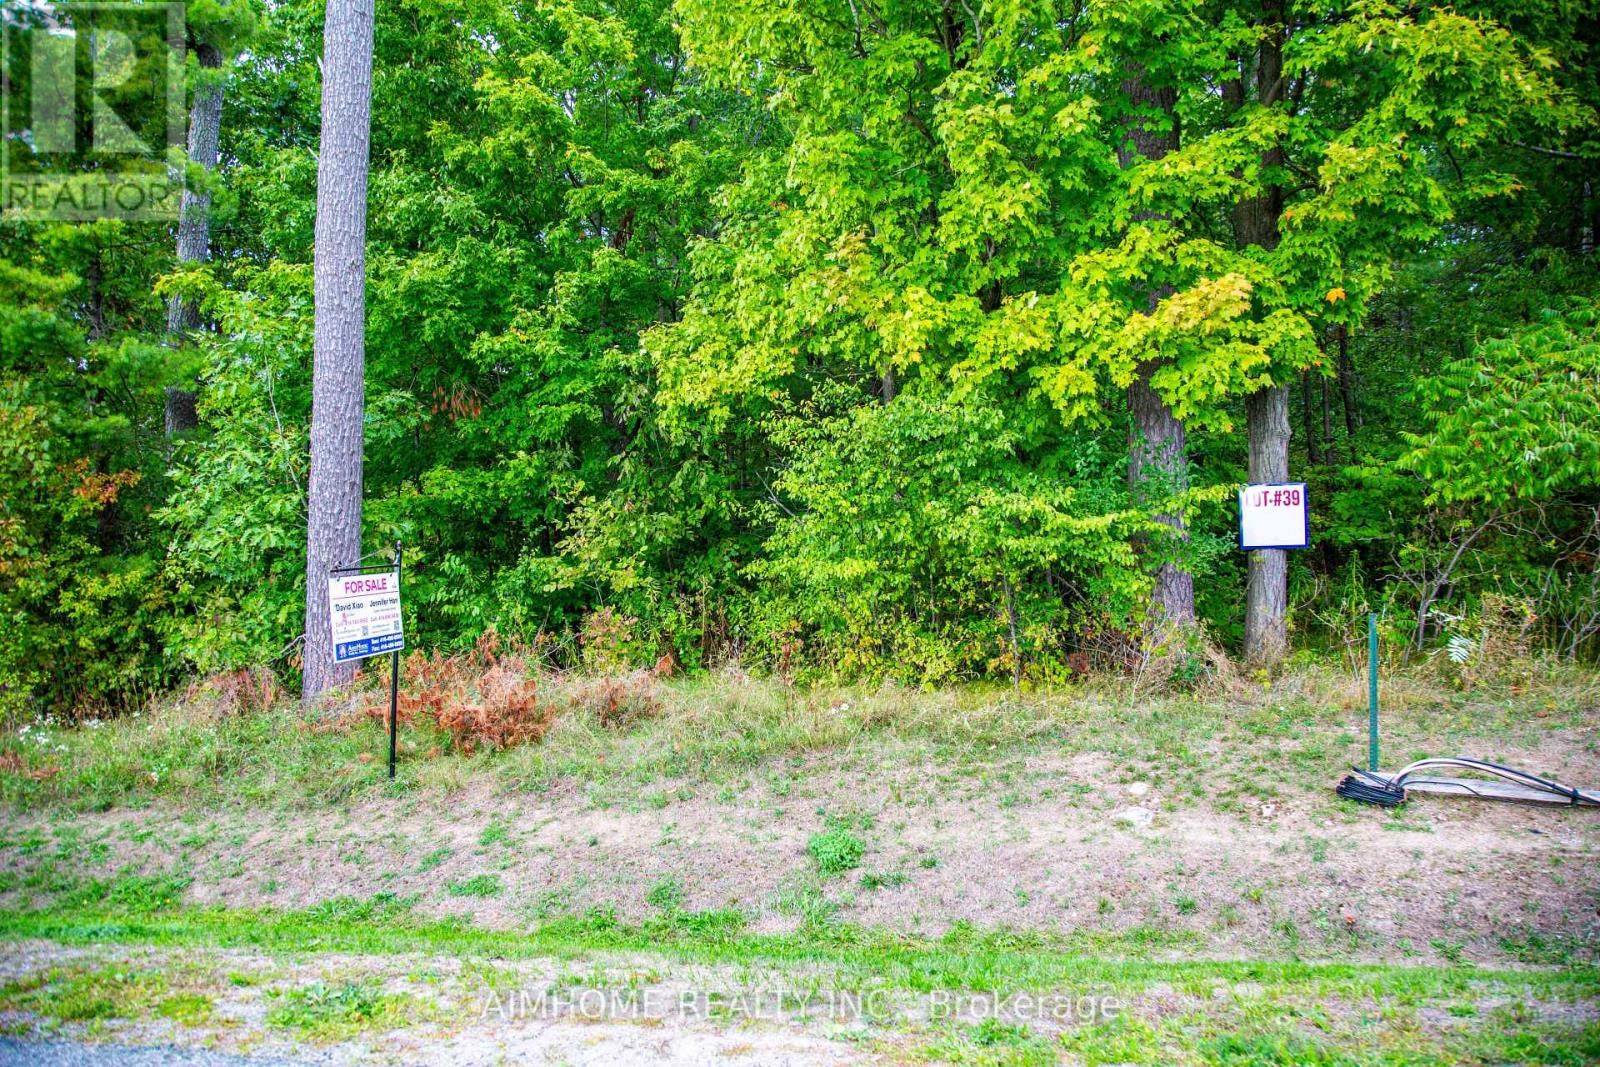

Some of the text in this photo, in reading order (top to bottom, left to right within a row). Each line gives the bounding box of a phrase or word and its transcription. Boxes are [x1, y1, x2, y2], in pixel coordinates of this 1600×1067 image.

[344, 578, 387, 594] FOR SALE
[335, 601, 364, 611] David Xiao
